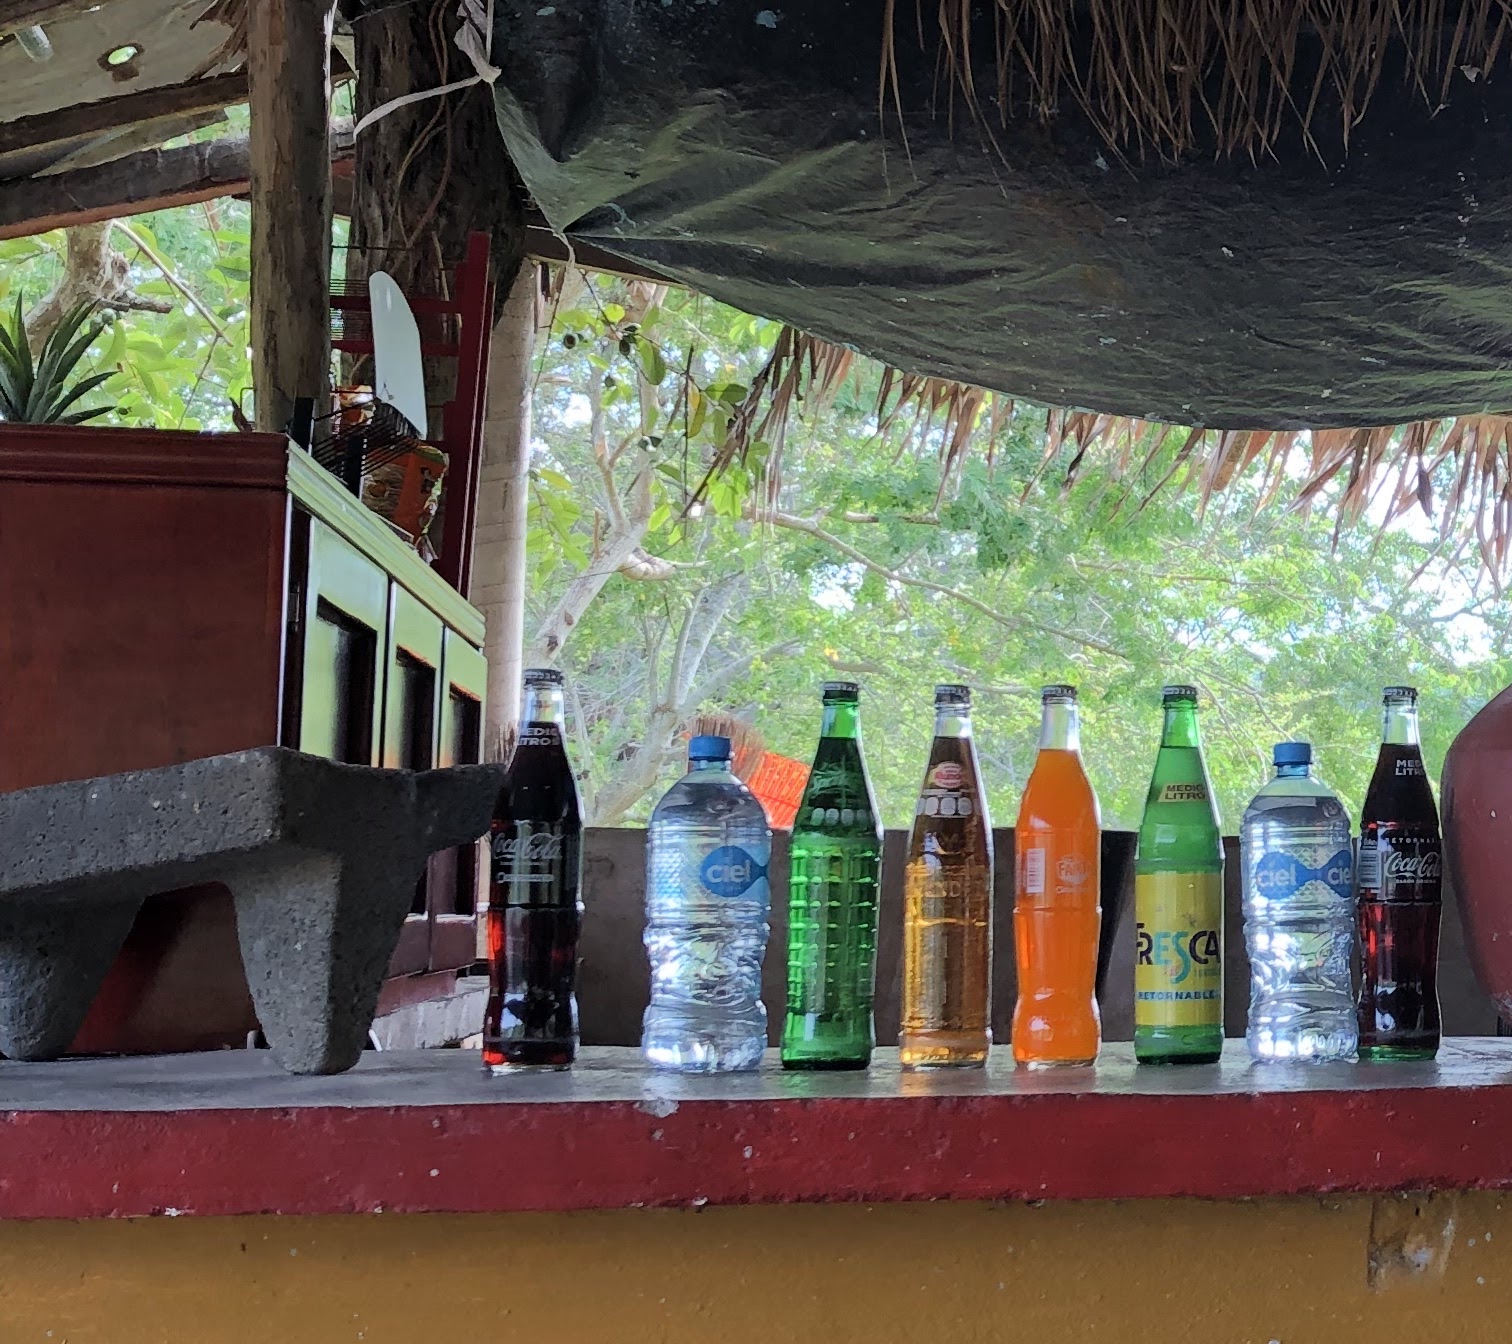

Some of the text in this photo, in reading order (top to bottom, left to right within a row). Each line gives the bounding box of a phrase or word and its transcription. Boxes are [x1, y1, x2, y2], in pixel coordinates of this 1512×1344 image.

[1396, 759, 1421, 768] MED
[1164, 792, 1206, 800] LITRO
[1166, 784, 1204, 792] MEDIO
[706, 859, 751, 884] ciel
[1256, 861, 1297, 887] ciel
[1327, 860, 1351, 885] cie
[1136, 922, 1221, 984] FRESCA
